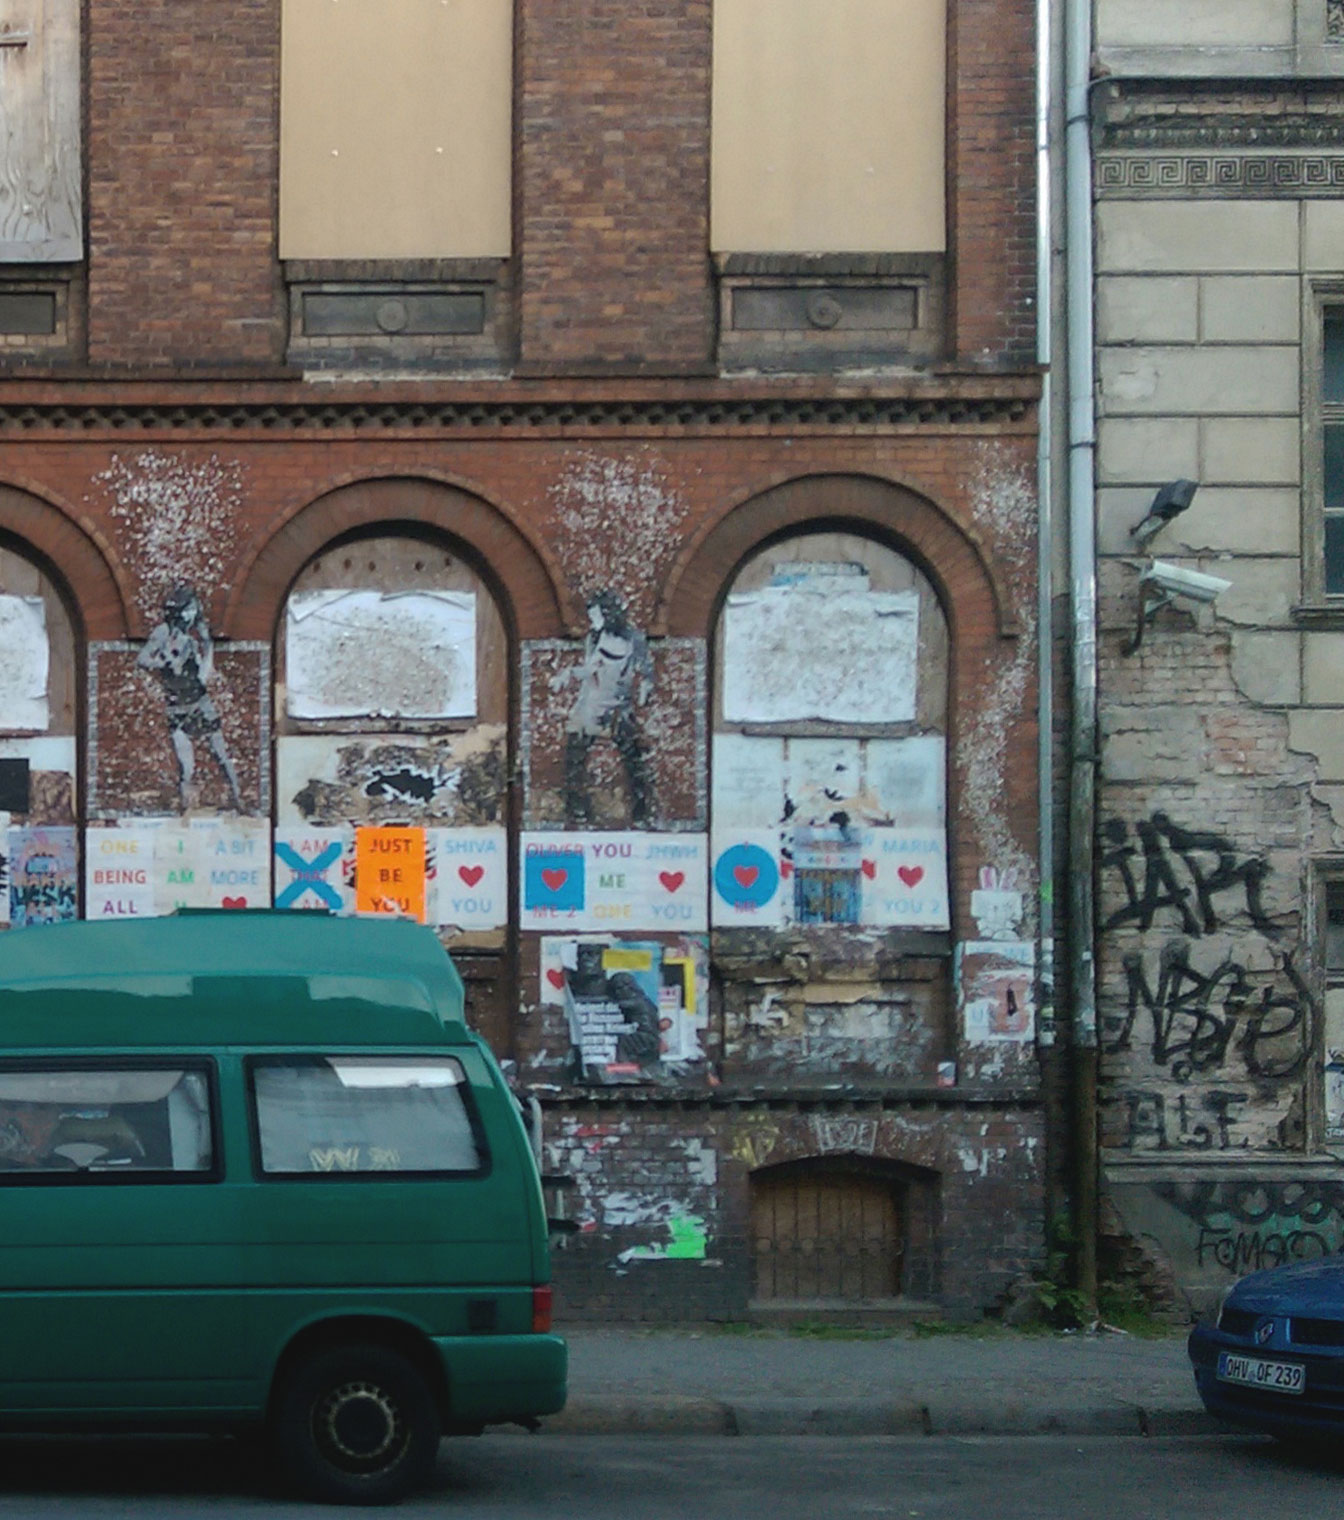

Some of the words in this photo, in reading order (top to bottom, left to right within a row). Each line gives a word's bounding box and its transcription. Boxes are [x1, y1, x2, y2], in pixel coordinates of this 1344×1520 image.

[101, 840, 138, 855] ONE
[178, 840, 184, 855] I
[300, 839, 329, 853] AM
[369, 839, 412, 854] JUST
[445, 840, 497, 854] SHIVA
[526, 843, 584, 857] OLIVER
[592, 844, 632, 858] YOU
[94, 870, 146, 885] BEING
[166, 870, 194, 885] AM
[210, 870, 260, 885] MORE
[380, 868, 402, 883] BE
[599, 873, 626, 889] ME
[103, 900, 138, 914] ALL
[452, 898, 493, 913] YOU
[533, 904, 557, 918] ME
[567, 904, 576, 918] 2
[594, 904, 632, 919] ONE
[651, 904, 692, 919] YOU
[885, 899, 923, 914] YOU
[1227, 1358, 1249, 1379] OHV
[1257, 1362, 1274, 1382] OF
[1275, 1365, 1302, 1387] 239
